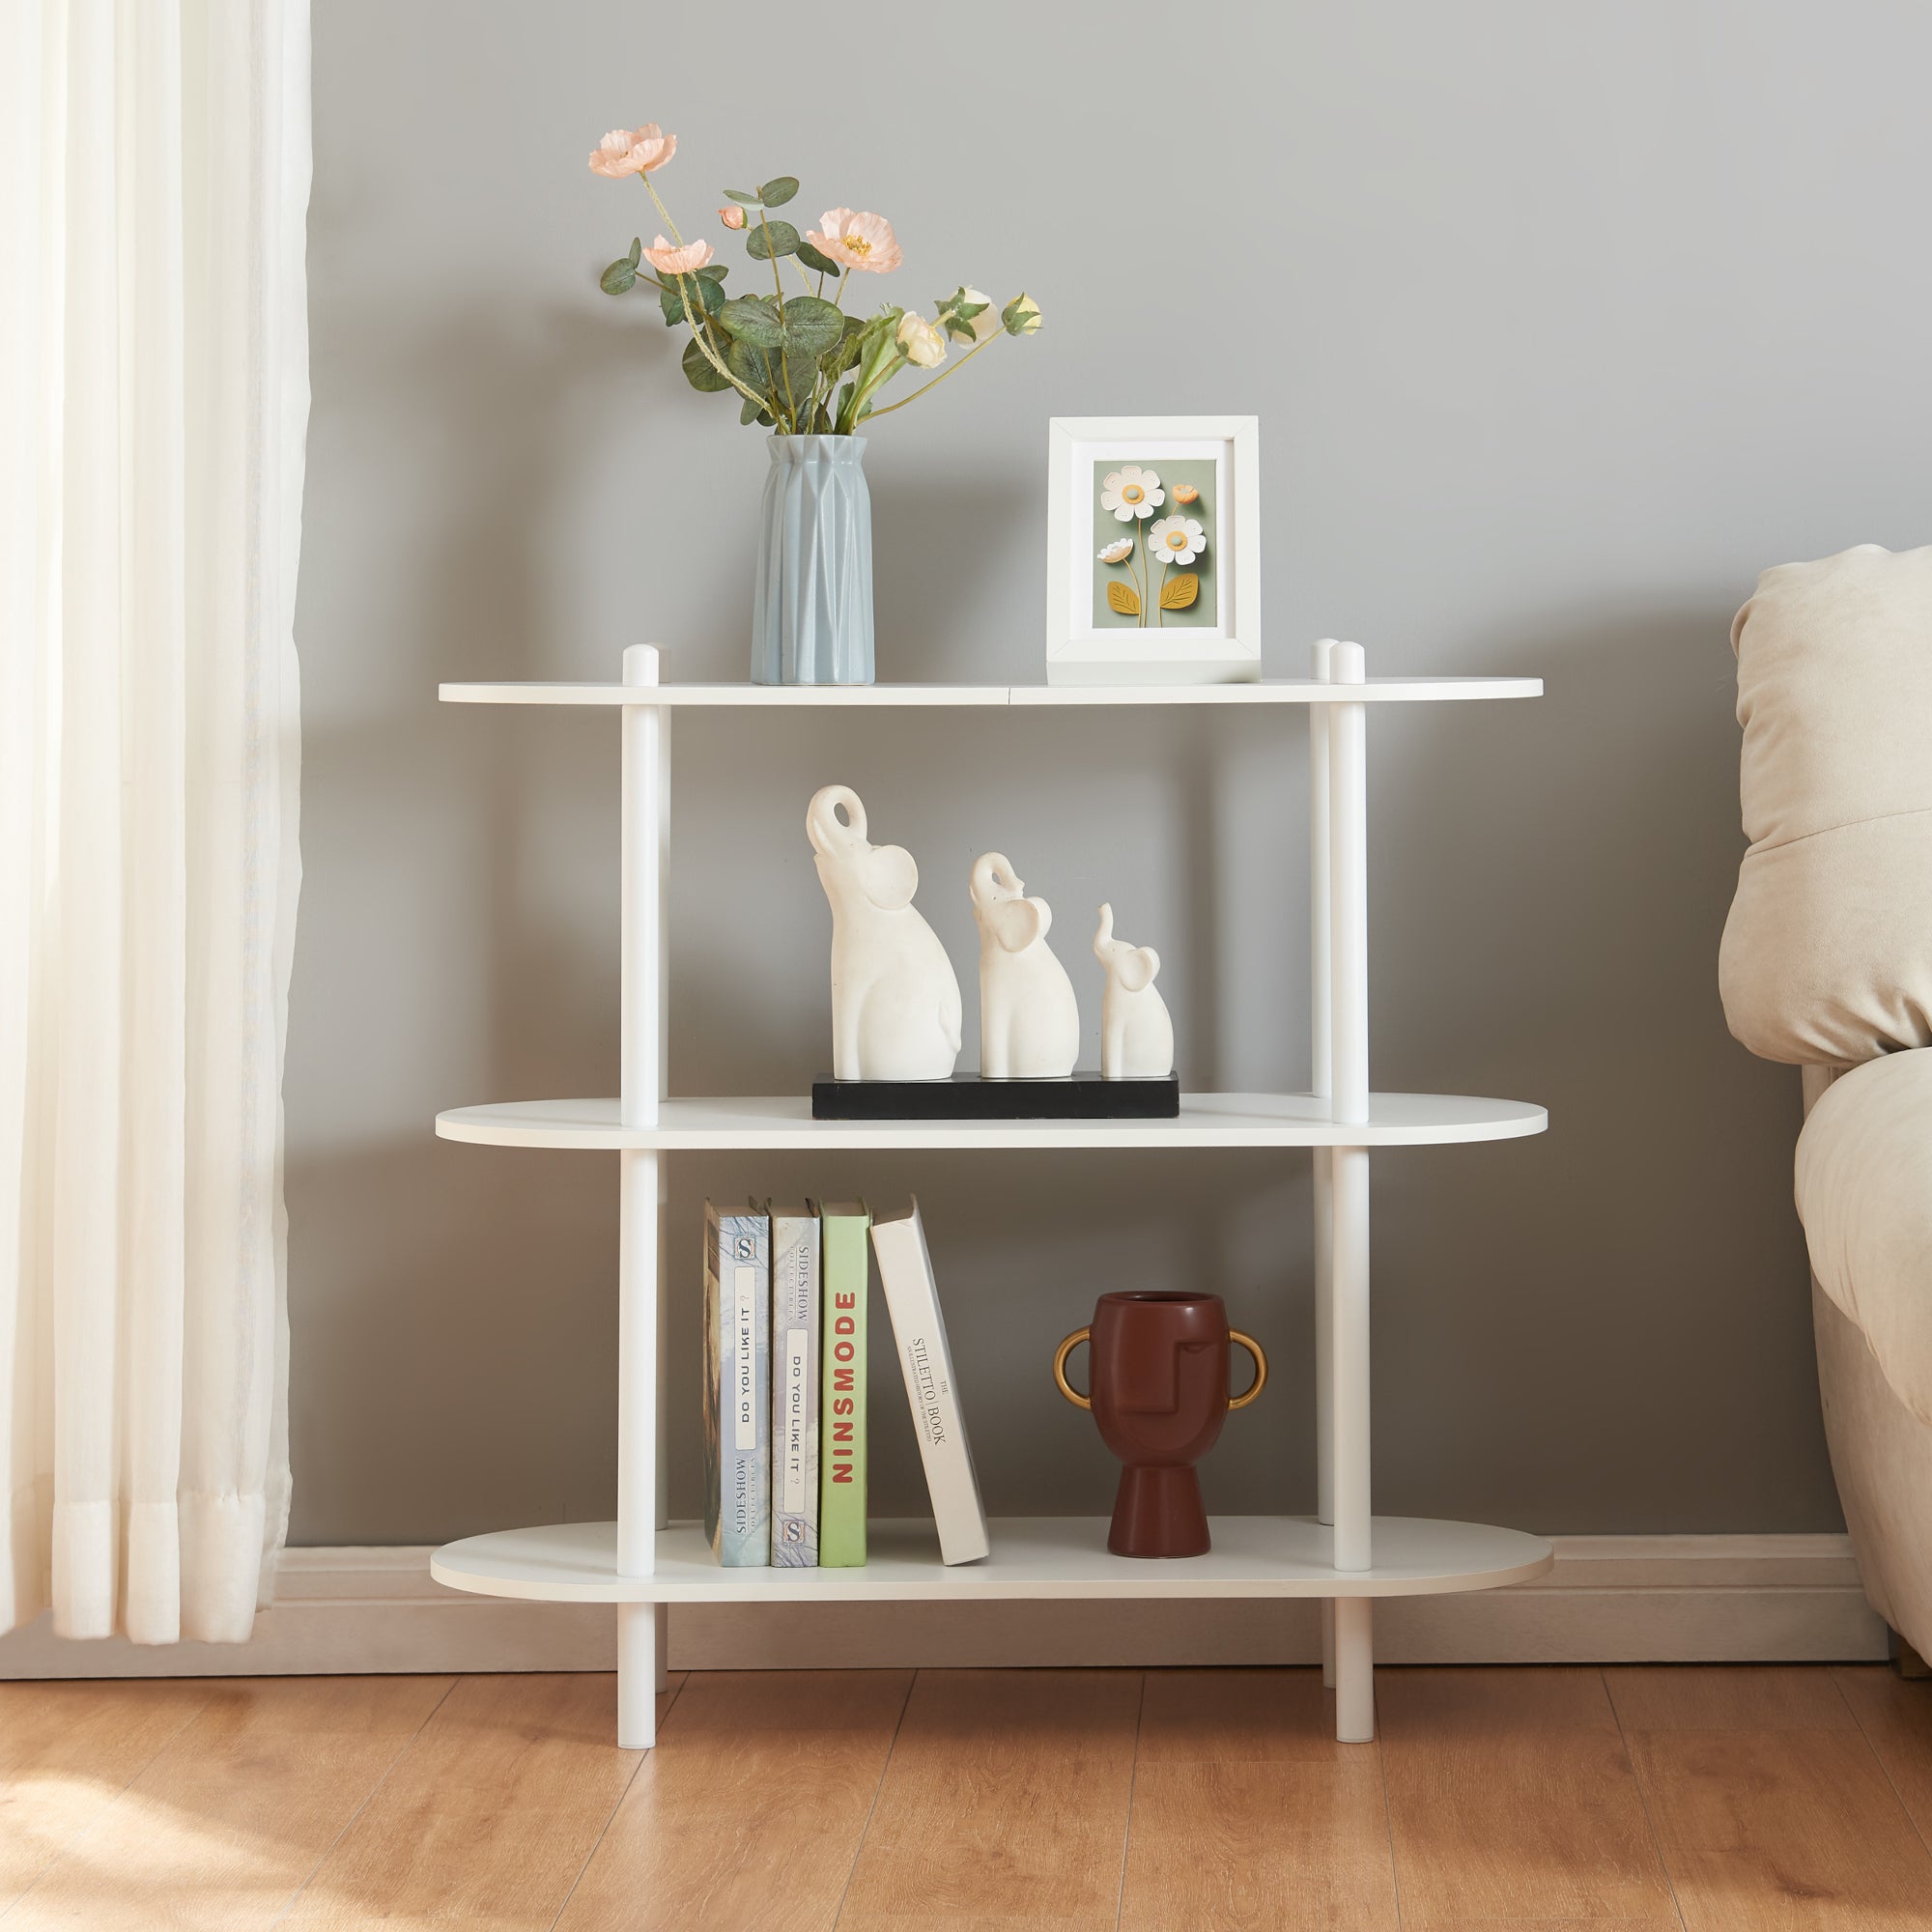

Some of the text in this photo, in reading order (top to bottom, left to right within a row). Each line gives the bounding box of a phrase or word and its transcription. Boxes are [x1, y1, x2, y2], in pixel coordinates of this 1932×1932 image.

[798, 1246, 810, 1321] SIDESHOW
[741, 1308, 751, 1321] IT
[741, 1327, 751, 1360] LIKE
[741, 1366, 751, 1396] YOU
[792, 1356, 801, 1378] DO
[792, 1383, 801, 1413] YOU
[833, 1292, 856, 1484] NINSMODE
[912, 1337, 947, 1446] STILETTO BOOK
[940, 1379, 949, 1395] THE
[741, 1402, 750, 1423] DO
[790, 1419, 801, 1452] LIKE
[790, 1458, 800, 1472] IT
[736, 1458, 747, 1534] SIDESHOW
